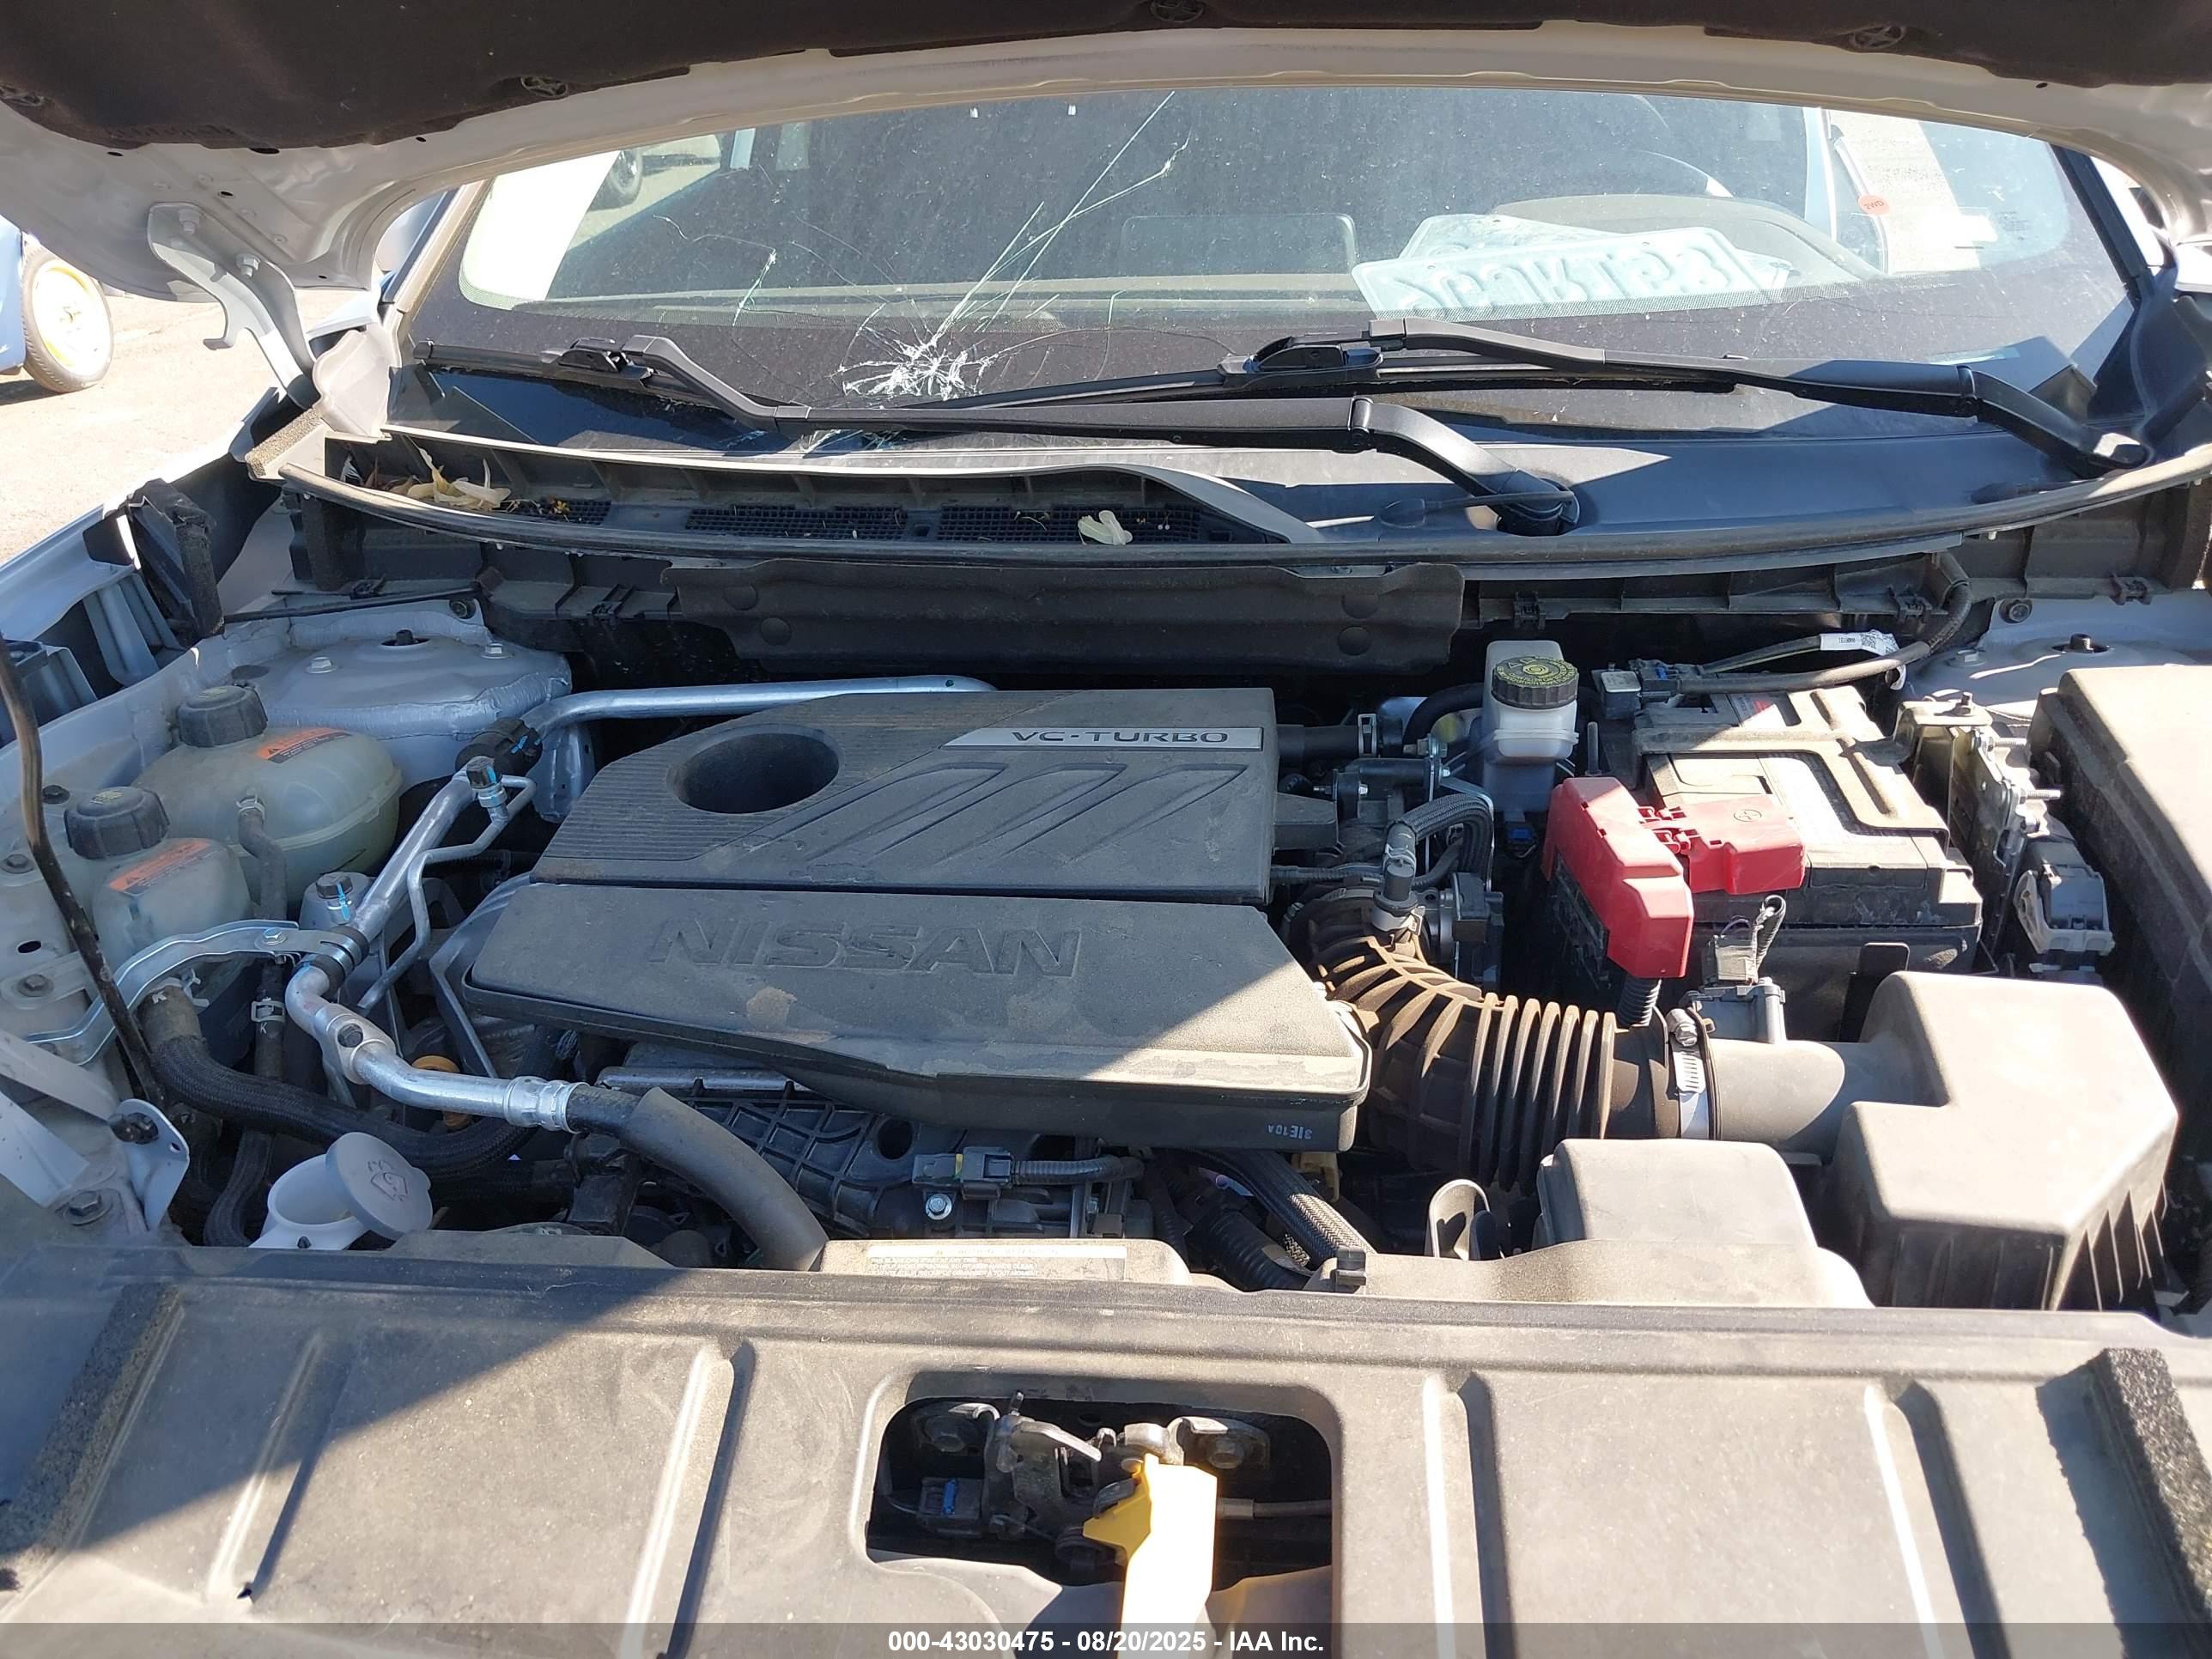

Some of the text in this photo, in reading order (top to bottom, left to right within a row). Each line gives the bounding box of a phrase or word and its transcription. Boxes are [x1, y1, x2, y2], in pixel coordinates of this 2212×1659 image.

[1011, 731, 1228, 743] VC-TURBO
[648, 919, 1082, 978] NISSAN
[260, 1022, 268, 1034] K
